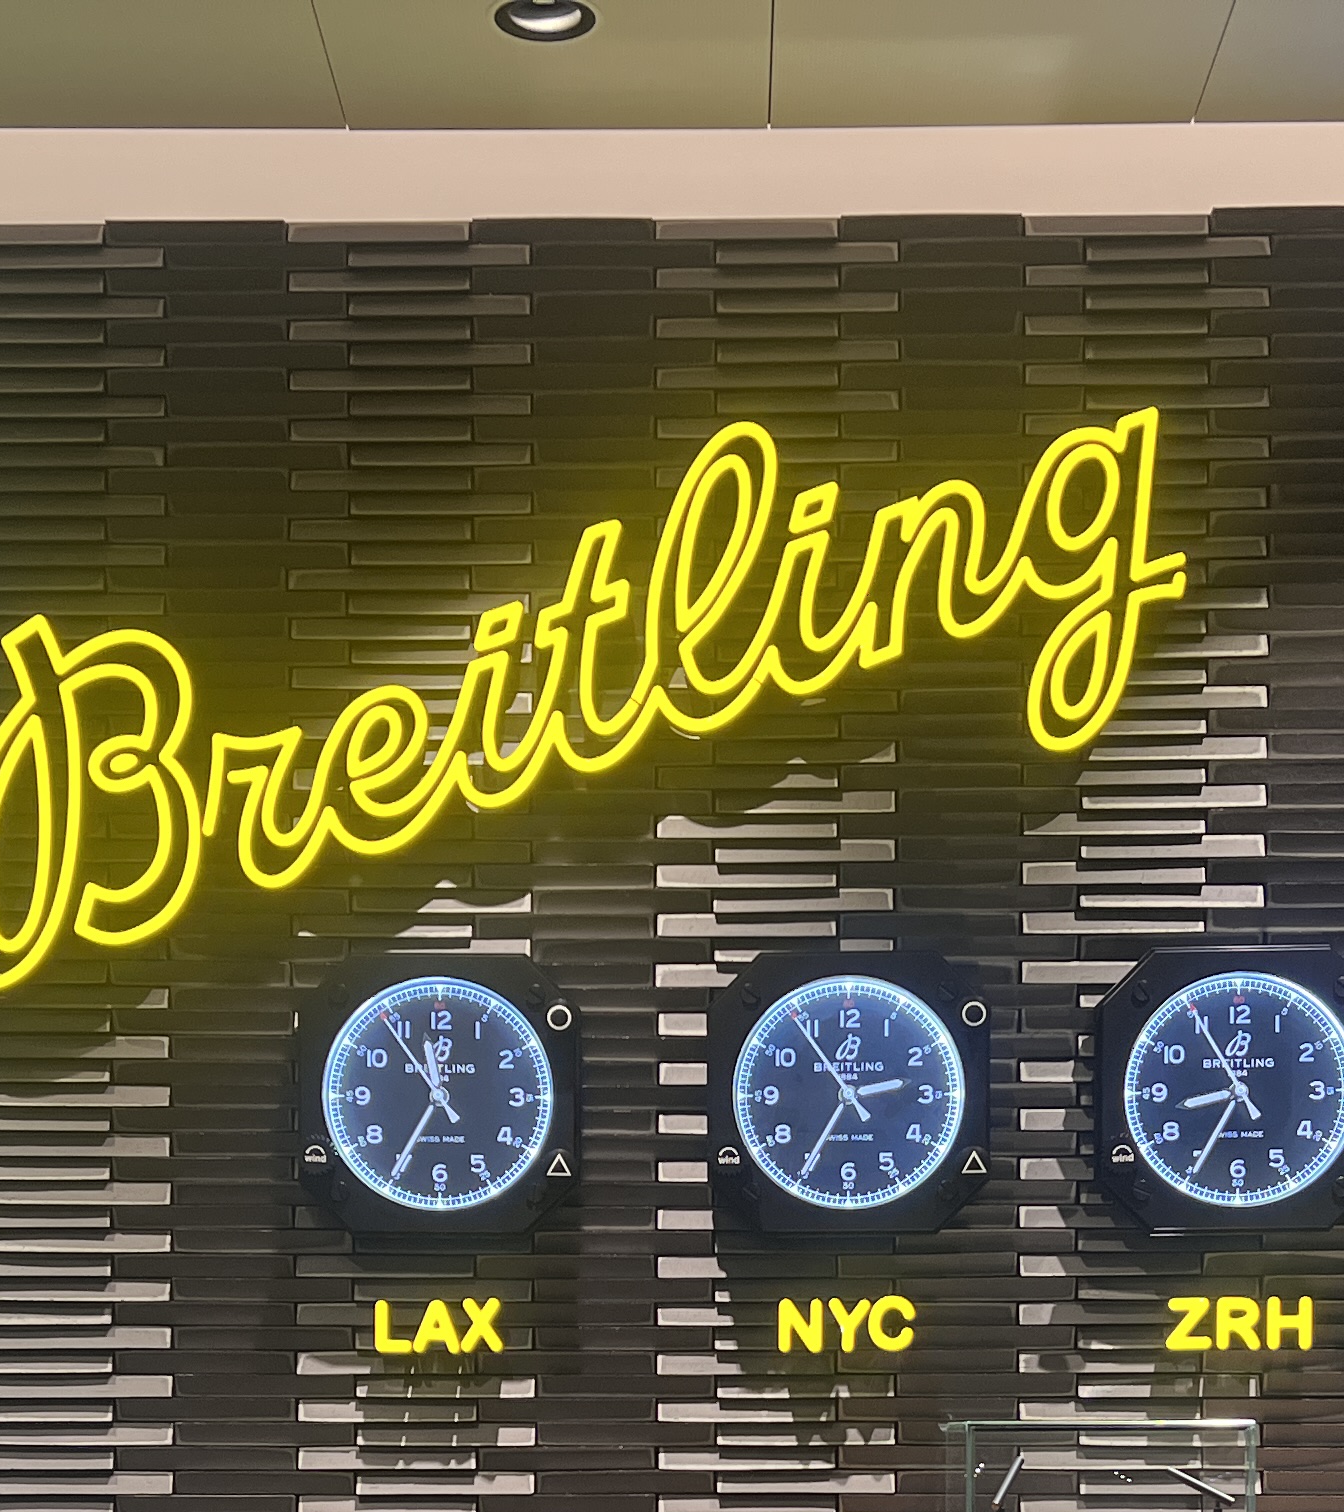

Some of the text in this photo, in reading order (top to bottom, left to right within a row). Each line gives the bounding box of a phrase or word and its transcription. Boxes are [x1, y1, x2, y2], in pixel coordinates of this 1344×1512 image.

[430, 1010, 452, 1030] 12
[840, 1010, 861, 1028] 12
[1229, 1006, 1251, 1024] 12
[1274, 1014, 1280, 1033] 1
[474, 1021, 480, 1040] 1
[884, 1020, 890, 1037] 1
[366, 1050, 388, 1068] 10
[498, 1050, 514, 1070] 2
[775, 1048, 796, 1067] 10
[908, 1048, 924, 1066] 2
[1164, 1044, 1184, 1064] 10
[1299, 1042, 1314, 1062] 2
[354, 1086, 370, 1106] 9
[509, 1088, 524, 1106] 3
[763, 1086, 779, 1104] 9
[918, 1085, 934, 1104] 3
[1152, 1083, 1168, 1102] 9
[1309, 1080, 1326, 1100] 3
[366, 1125, 382, 1144] 8
[497, 1127, 513, 1145] 4
[774, 1125, 792, 1143] 8
[906, 1124, 922, 1142] 4
[1163, 1122, 1180, 1140] 8
[1297, 1120, 1312, 1139] 4
[304, 1153, 326, 1163] wind
[470, 1154, 486, 1172] 5
[718, 1154, 740, 1164] wind
[879, 1152, 894, 1170] 5
[1112, 1153, 1134, 1162] wind
[1268, 1149, 1284, 1168] 5
[432, 1164, 448, 1182] 6
[840, 1162, 856, 1180] 6
[1230, 1160, 1246, 1178] 6
[376, 1299, 503, 1354] LAX
[780, 1296, 915, 1353] NYC
[1167, 1297, 1312, 1350] ZRH
